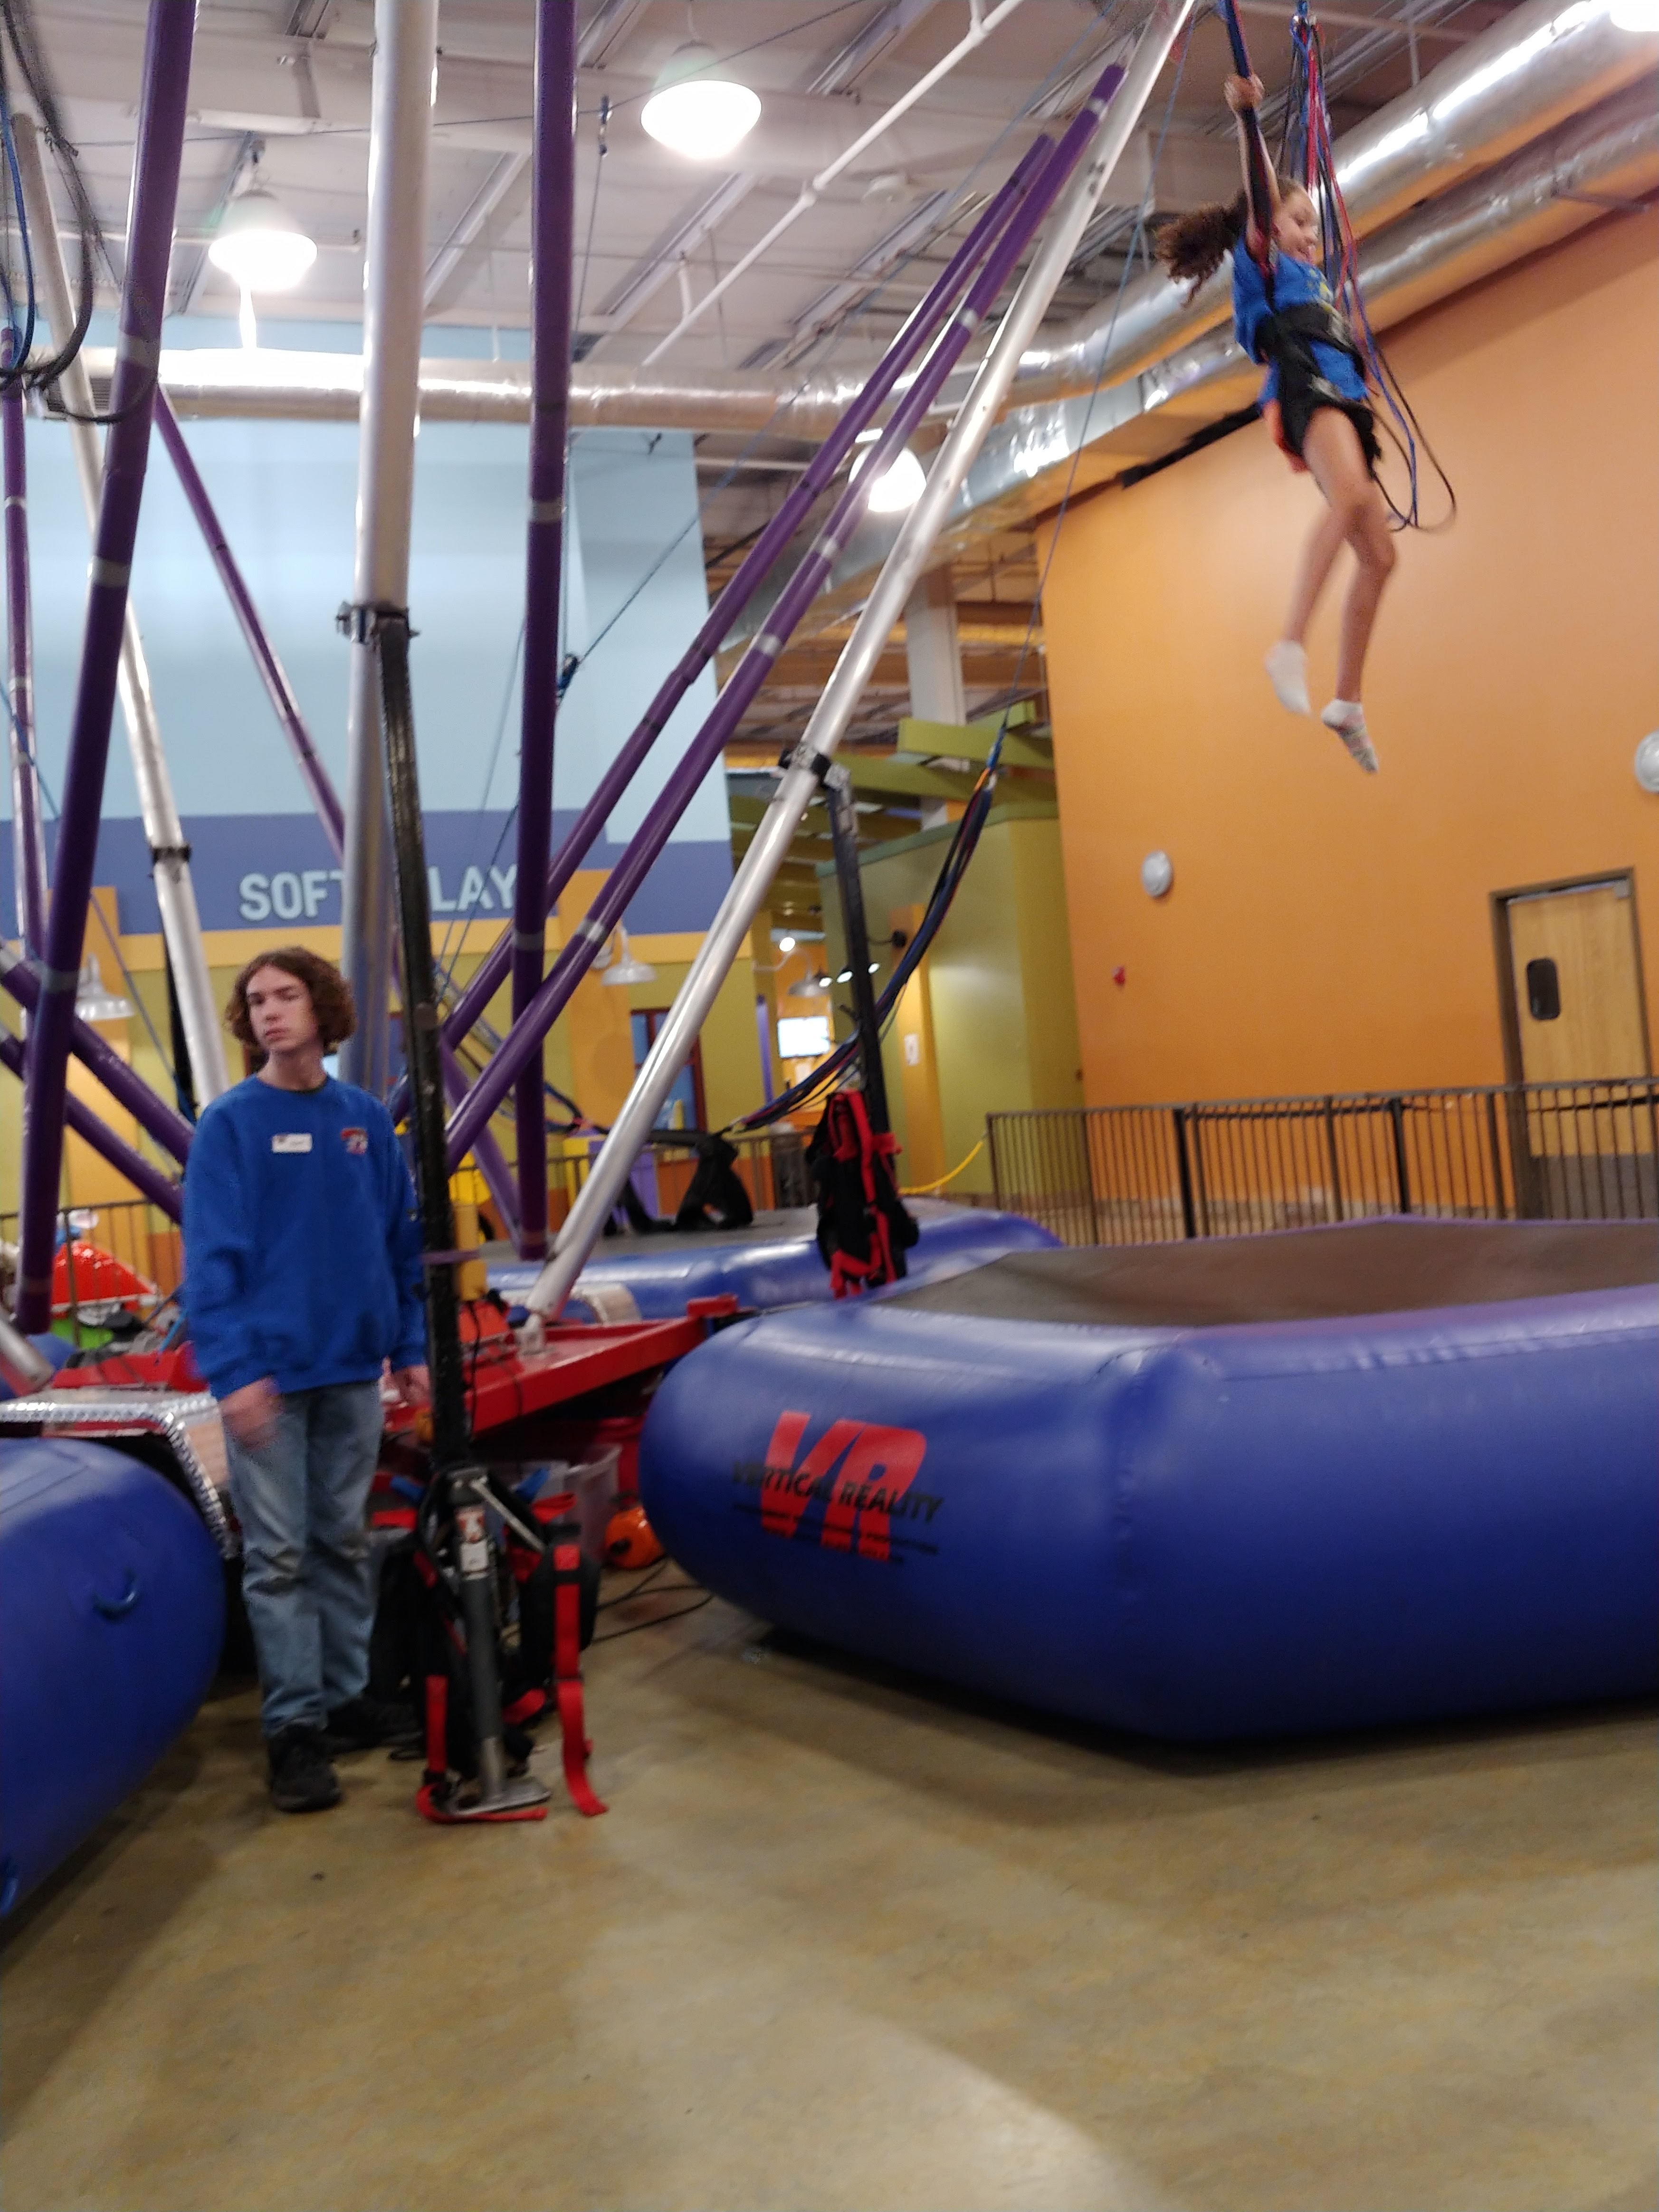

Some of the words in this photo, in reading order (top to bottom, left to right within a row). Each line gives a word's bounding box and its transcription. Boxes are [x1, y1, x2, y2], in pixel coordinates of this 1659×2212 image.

[428, 863, 518, 911] LAY
[761, 1410, 927, 1564] VR
[838, 1478, 944, 1523] REALITY
